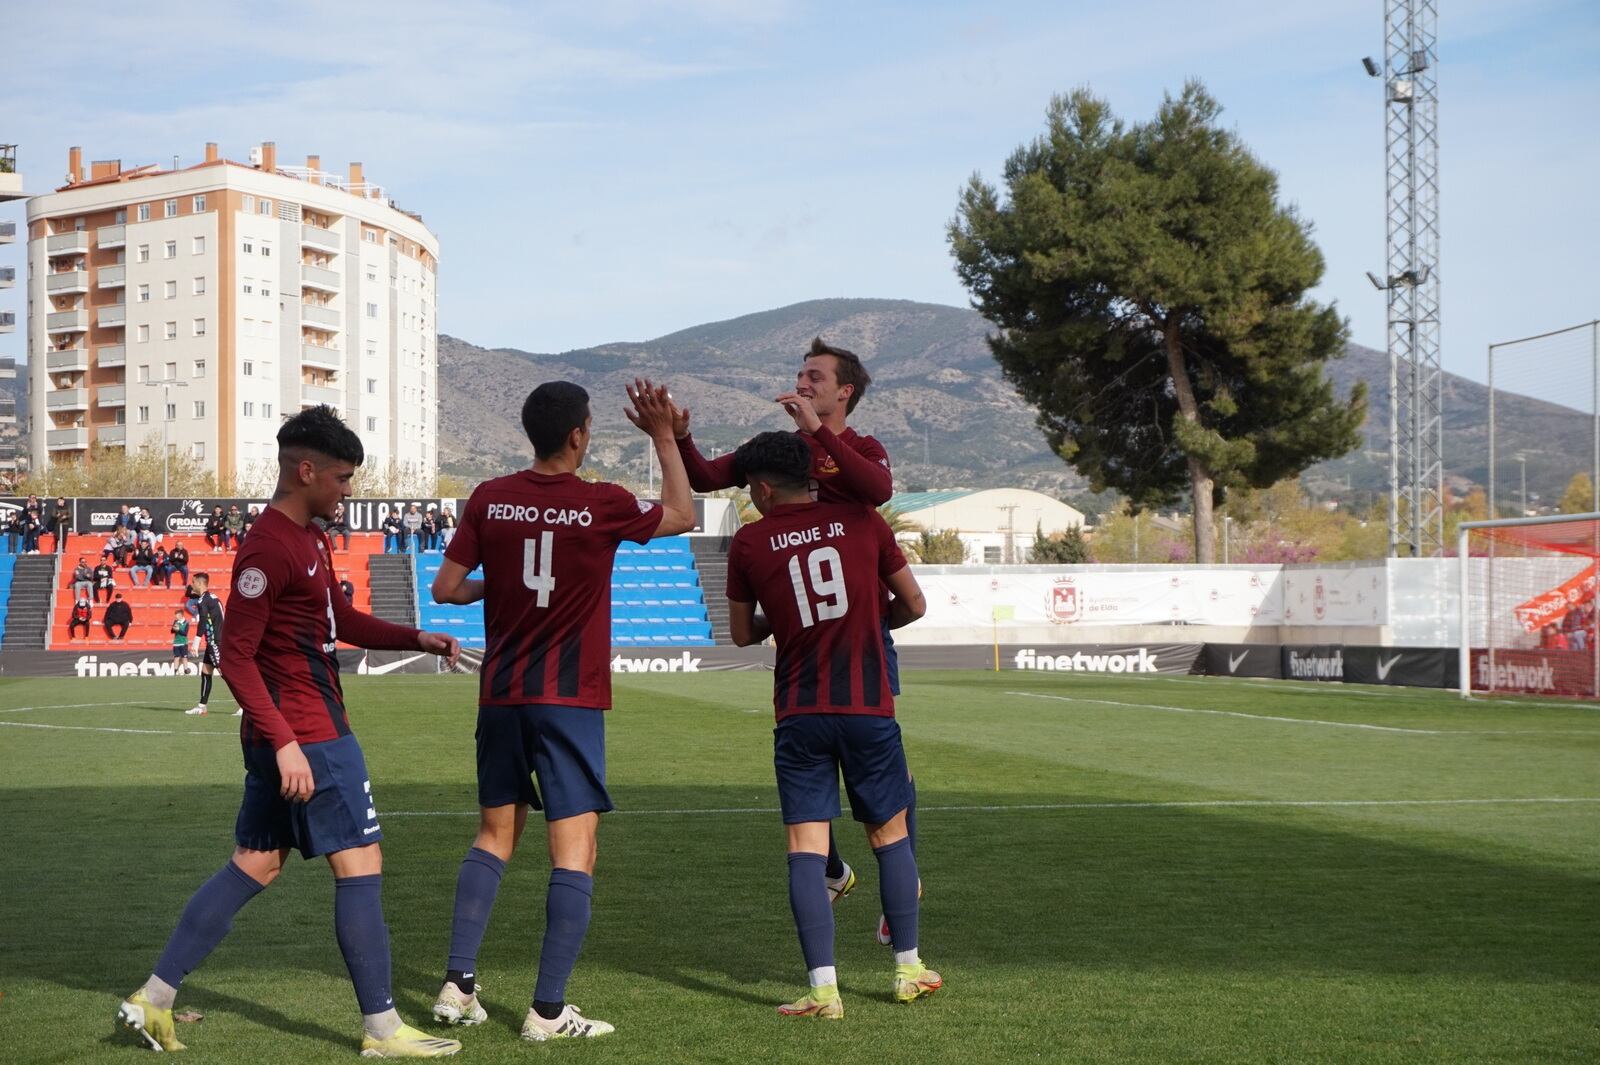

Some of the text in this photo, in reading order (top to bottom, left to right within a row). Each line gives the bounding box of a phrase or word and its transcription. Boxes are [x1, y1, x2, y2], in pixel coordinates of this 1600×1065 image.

[487, 503, 593, 527] PEDRO CAPÓ
[770, 522, 846, 551] LUQUE JR
[523, 530, 556, 608] 4
[788, 546, 849, 628] 19
[75, 655, 222, 677] finetwo
[610, 651, 702, 672] twork
[1014, 648, 1158, 672] finetwork
[1290, 650, 1344, 677] finetwork
[1478, 655, 1555, 690] fietwork
